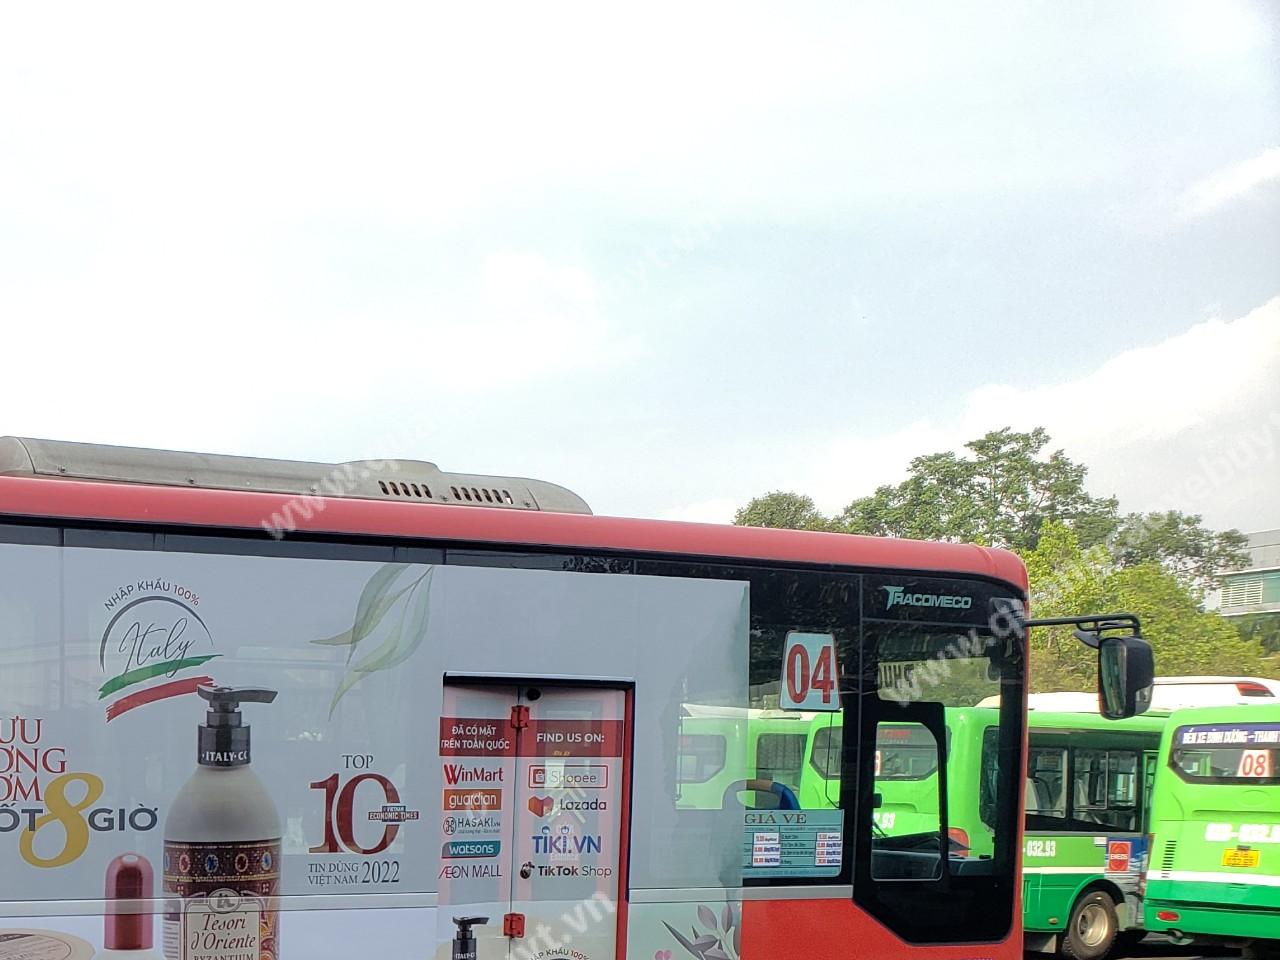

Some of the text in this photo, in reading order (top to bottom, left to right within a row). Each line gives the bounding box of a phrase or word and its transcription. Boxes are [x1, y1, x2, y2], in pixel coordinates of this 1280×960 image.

[104, 581, 135, 612] NHẬP
[173, 584, 202, 607] 100%
[883, 585, 972, 610] TRACOMECO
[118, 617, 197, 678] Italy
[786, 643, 835, 705] 04
[466, 726, 477, 734] CÓ
[536, 733, 605, 743] FIND US ON:
[342, 754, 374, 769] TOP
[1242, 754, 1266, 776] 08
[443, 764, 504, 785] WinMart
[551, 771, 597, 786] Shopee
[449, 793, 496, 807] guardian
[560, 798, 607, 811] Lazada
[19, 772, 104, 868] 8
[88, 807, 159, 832] GIỜ
[309, 773, 401, 855] 10
[745, 811, 777, 824] GIÁ
[449, 843, 494, 854] watsons
[308, 863, 325, 873] TIN
[362, 861, 400, 883] 2022
[472, 865, 503, 878] MALL
[538, 865, 612, 878] TikTok Shop
[308, 874, 358, 886] VIỆT NAM
[202, 912, 248, 931] Tesori
[190, 931, 256, 950] d'Oriente
